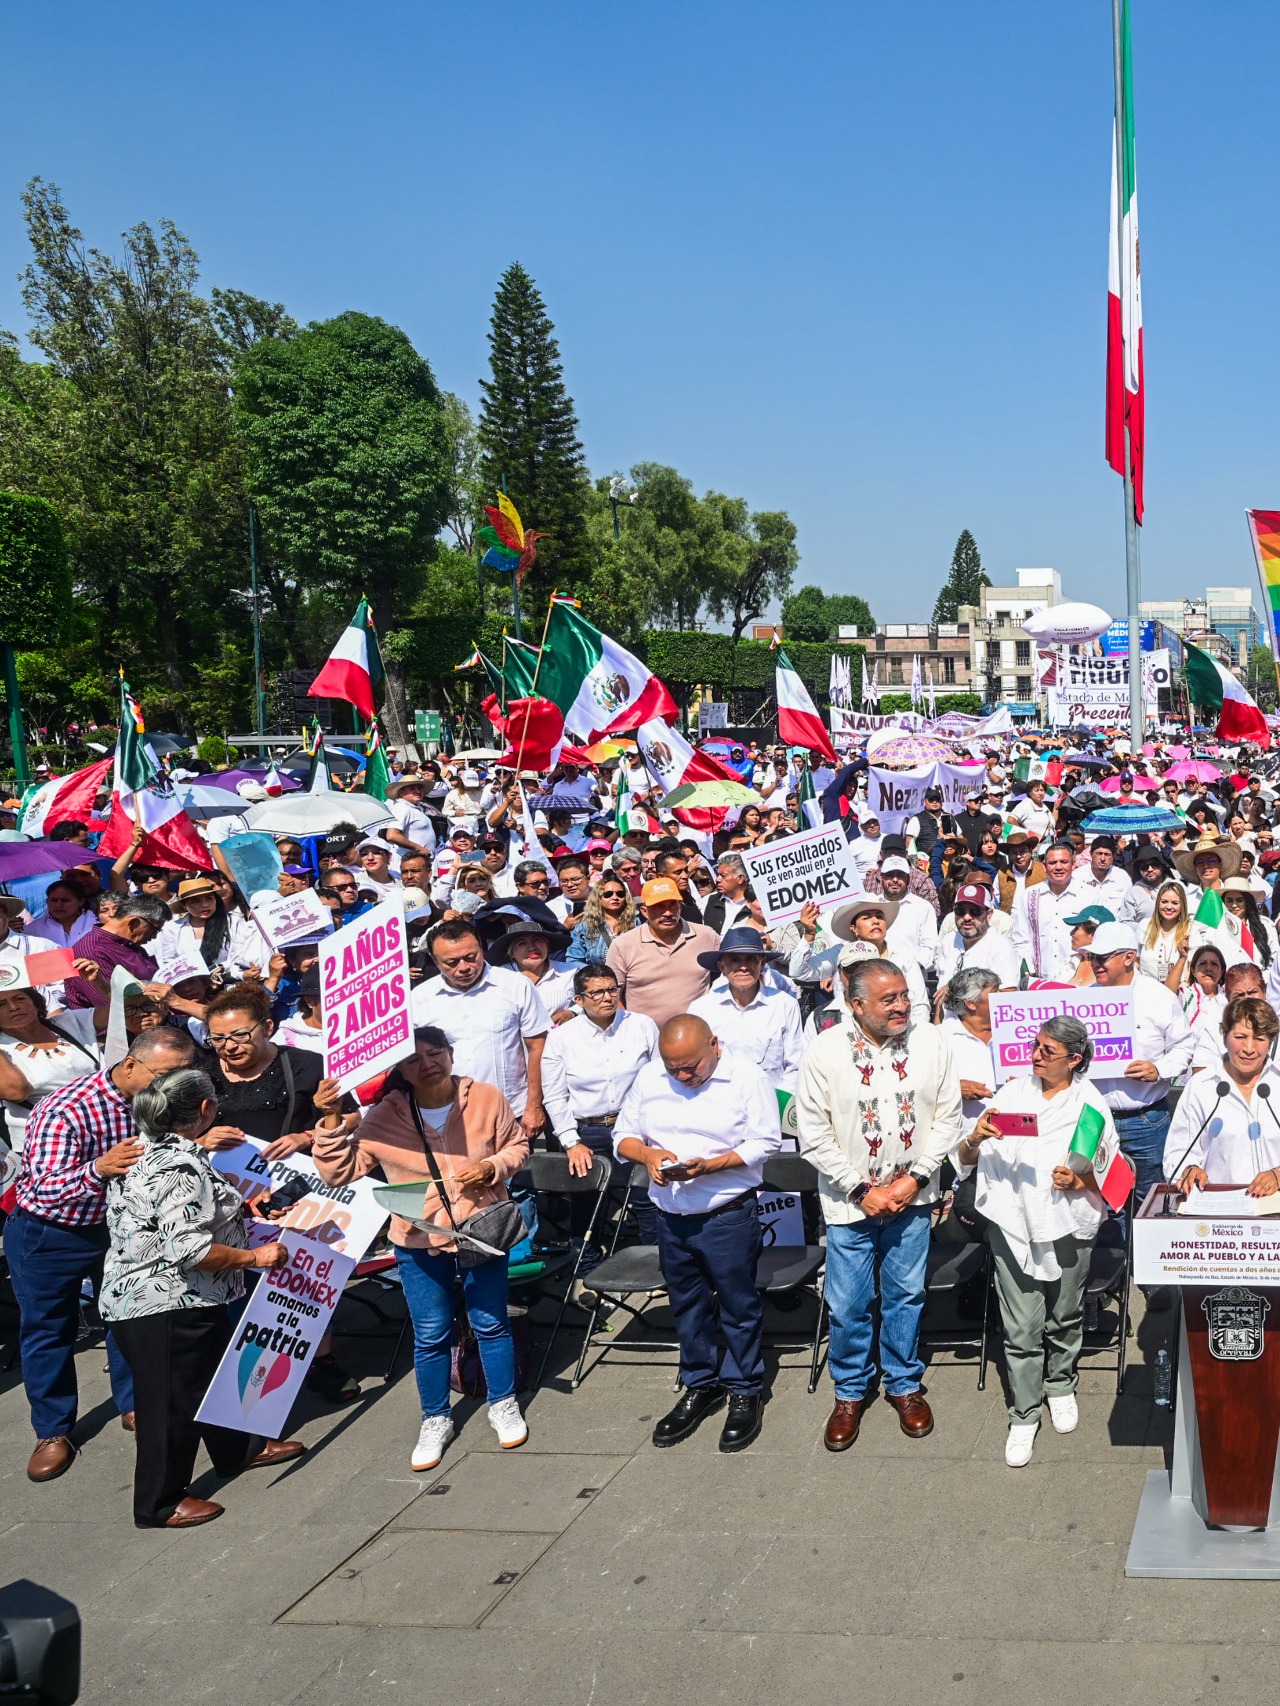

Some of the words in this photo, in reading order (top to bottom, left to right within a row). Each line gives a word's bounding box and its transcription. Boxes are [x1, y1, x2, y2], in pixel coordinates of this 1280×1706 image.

[879, 782, 918, 812] Neza
[750, 858, 773, 878] Sus
[775, 836, 842, 871] resultados
[767, 873, 776, 886] se
[778, 869, 794, 881] ven
[795, 862, 813, 879] aquí
[815, 860, 826, 871] en
[827, 856, 835, 867] el
[767, 867, 850, 911] EDOMÉX
[324, 956, 337, 991] 2
[342, 917, 400, 980] AÑOS
[326, 989, 340, 1007] DE
[344, 959, 400, 995] VICTORIA,
[327, 1012, 340, 1049] 2
[345, 973, 405, 1038] AÑOS
[994, 1004, 1025, 1028] ¡Es
[1028, 1005, 1057, 1021] un
[1061, 1000, 1129, 1019] honor
[330, 1029, 405, 1079] MEXIQUENSE
[331, 1048, 346, 1065] DE
[349, 1015, 403, 1054] ORGULLO
[244, 1153, 269, 1175] La
[1171, 1241, 1238, 1251] HONESTIDAD,
[1212, 1228, 1244, 1236] México
[291, 1248, 315, 1273] En
[316, 1259, 334, 1279] el
[1160, 1252, 1191, 1260] AMOR
[1193, 1252, 1205, 1260] AL
[1208, 1252, 1247, 1260] PUEBLO
[1258, 1253, 1265, 1261] A
[1268, 1253, 1280, 1261] LA
[266, 1266, 338, 1310] EDOMÉX,
[266, 1290, 320, 1319] amamos
[277, 1311, 287, 1324] a
[285, 1312, 300, 1329] la
[235, 1321, 312, 1361] patria
